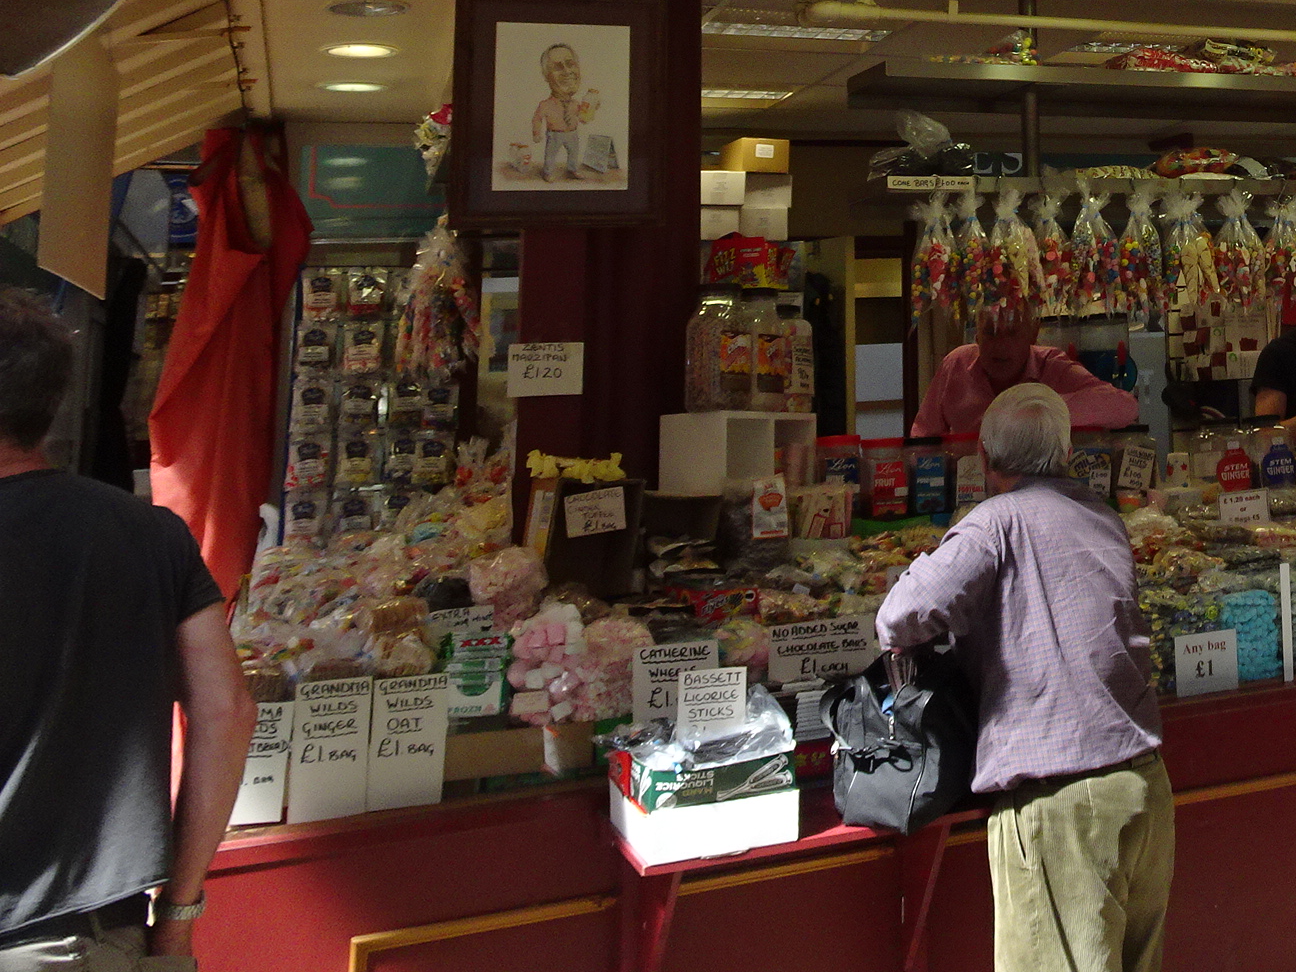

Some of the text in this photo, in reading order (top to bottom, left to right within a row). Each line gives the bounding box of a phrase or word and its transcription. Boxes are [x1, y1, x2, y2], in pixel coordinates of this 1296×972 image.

[1223, 463, 1248, 471] STEM
[1269, 458, 1292, 466] STEM
[1221, 470, 1250, 480] GINGER
[1266, 465, 1295, 475] GINGER
[874, 478, 896, 487] FRUIT
[772, 624, 827, 638] NO ADDED
[460, 637, 501, 647] XXX
[777, 641, 840, 656] CHOCOLATE
[1182, 639, 1227, 655] Any bag
[639, 646, 711, 660] CATHERINE
[821, 662, 849, 672] EACH
[1195, 660, 1214, 678] £1
[379, 675, 448, 692] GRANDMA
[683, 672, 742, 686] BASSETT
[300, 681, 370, 698] GRANDMA
[683, 689, 739, 702] LICORICE
[310, 700, 358, 713] WILDS
[386, 695, 433, 709] WILDS
[688, 705, 734, 719] STICKS
[302, 718, 358, 734] GINGER
[386, 717, 423, 730] OAT
[329, 749, 357, 762] BAG
[407, 743, 434, 756] BAG
[676, 771, 715, 782] STICKS
[655, 779, 714, 791] LIQUORICE
